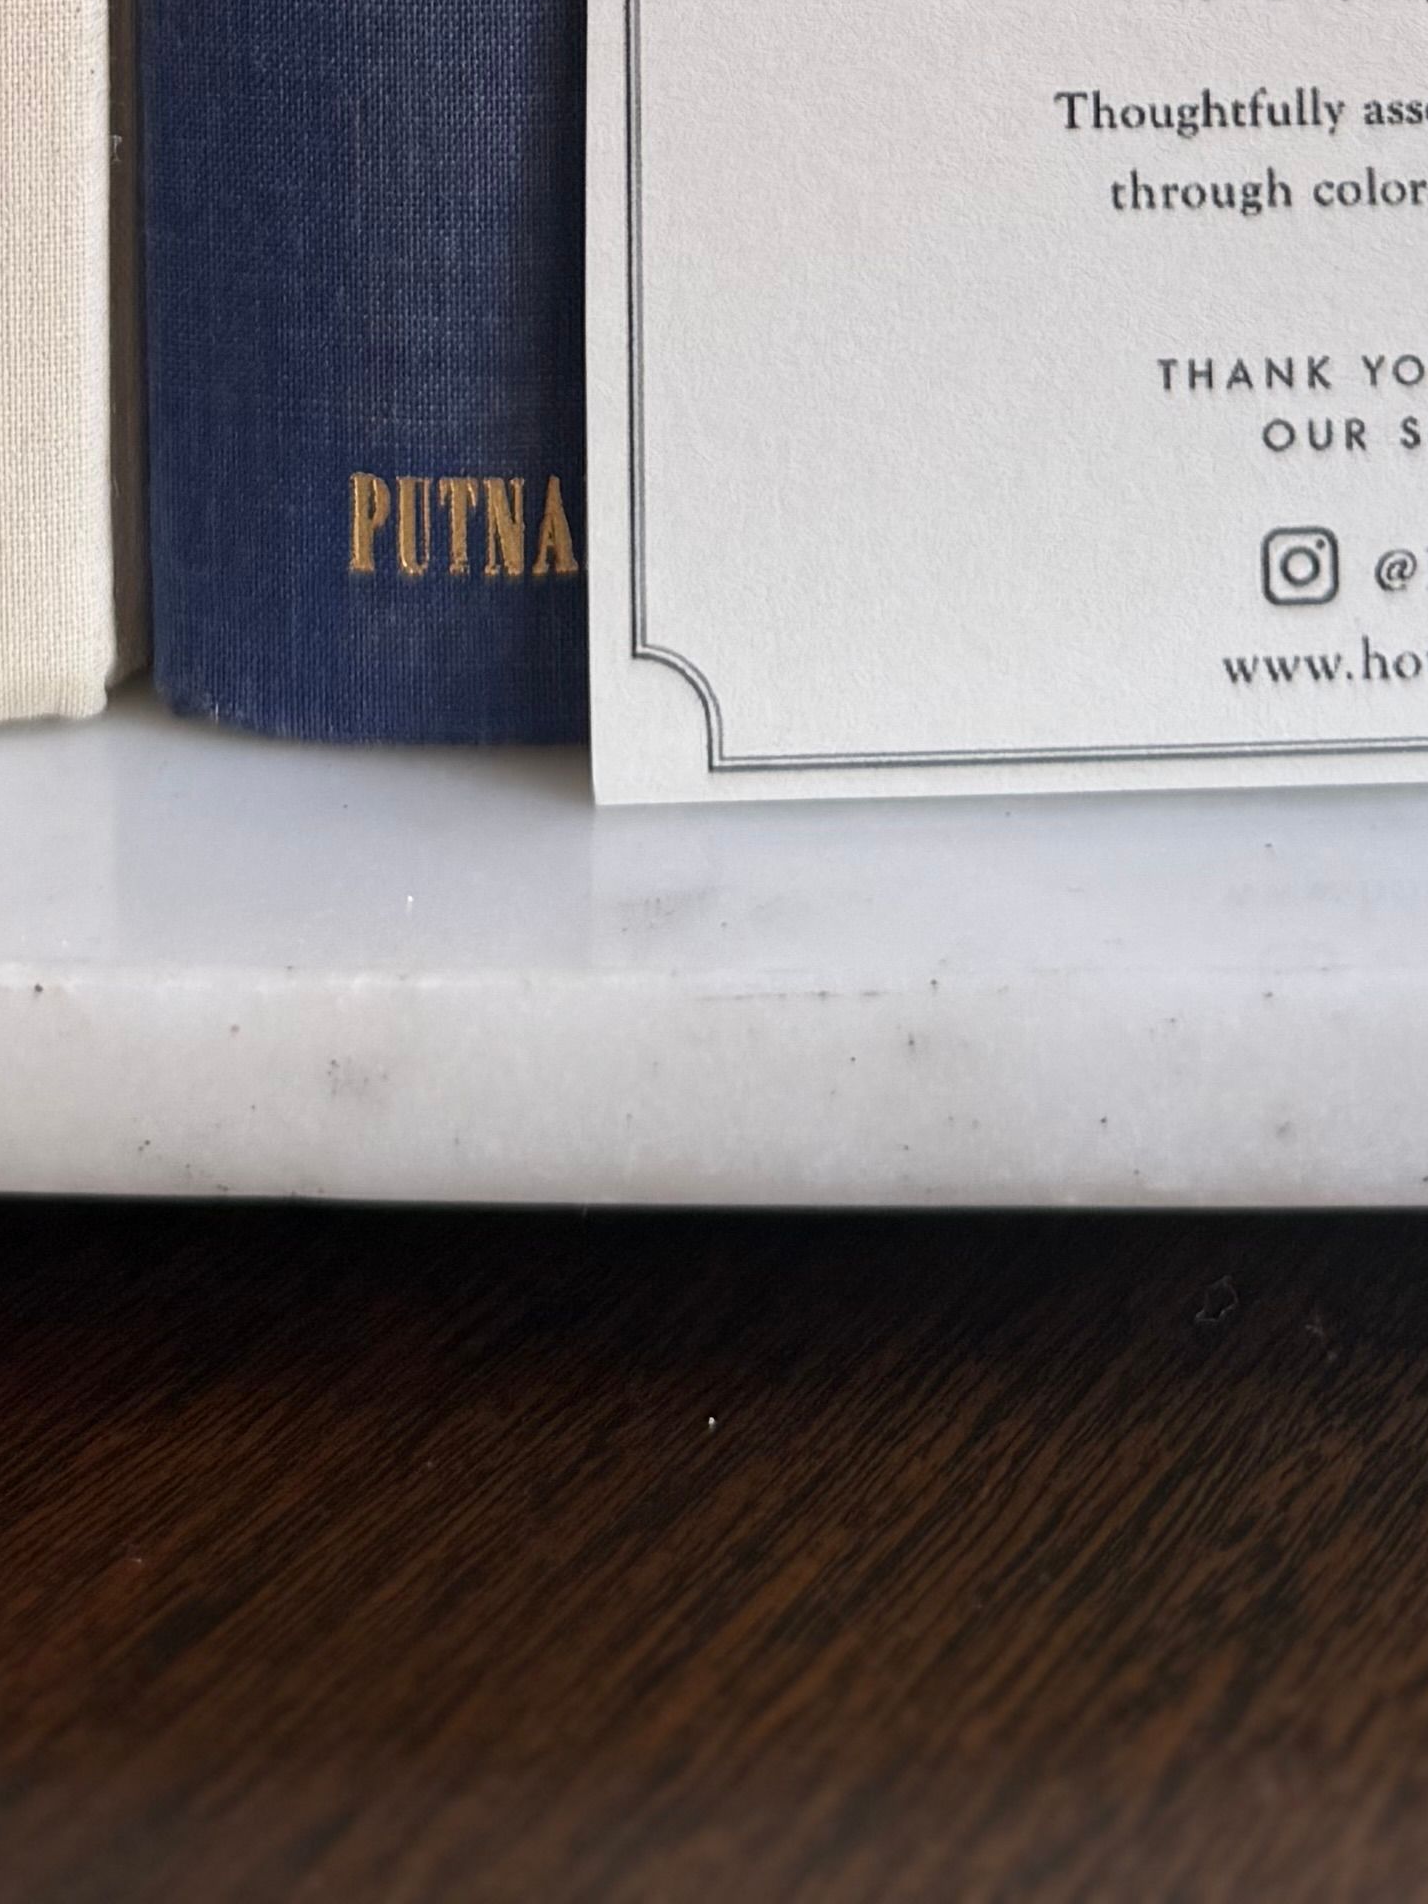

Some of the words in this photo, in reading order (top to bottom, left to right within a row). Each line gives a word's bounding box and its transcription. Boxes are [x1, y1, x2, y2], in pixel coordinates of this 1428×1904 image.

[1052, 85, 1348, 141] Thoughtfully
[1110, 165, 1294, 219] through
[1156, 355, 1334, 393] THANK
[1261, 416, 1369, 455] OUR
[348, 471, 586, 577] PUTNA
